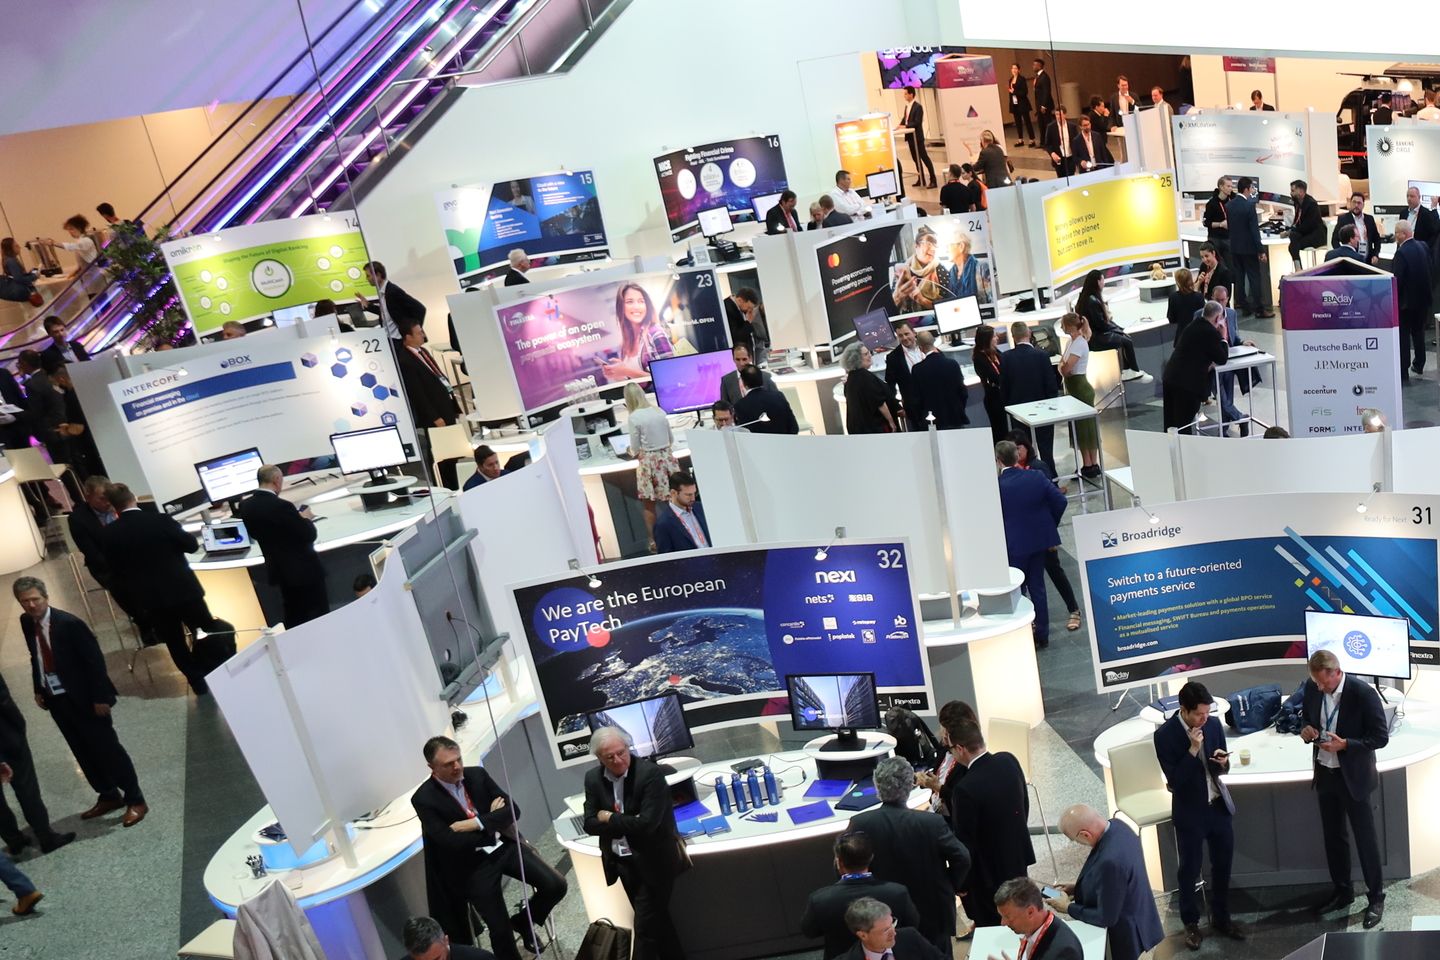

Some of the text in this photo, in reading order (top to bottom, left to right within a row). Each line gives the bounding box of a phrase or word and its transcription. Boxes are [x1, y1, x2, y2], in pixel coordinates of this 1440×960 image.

[1295, 128, 1302, 137] 46
[768, 138, 779, 148] 16
[701, 148, 720, 158] Financial
[580, 174, 592, 185] 15
[1160, 176, 1172, 188] 25
[345, 217, 359, 230] 14
[1085, 212, 1096, 222] you
[968, 220, 982, 232] 24
[1082, 223, 1100, 235] planet
[1076, 239, 1088, 248] save
[696, 274, 713, 288] 23
[831, 273, 851, 286] Powering
[858, 276, 872, 286] people
[1322, 294, 1353, 305] EBAday
[515, 319, 606, 352] The power of an open
[556, 332, 602, 350] ecosystem
[362, 339, 382, 354] 22
[1302, 342, 1362, 352] Deutsche Bank
[228, 354, 252, 368] BOX
[1314, 360, 1369, 372] J.P.Morgan
[122, 374, 180, 396] INTERCOPE
[1304, 386, 1337, 394] accenture
[1312, 408, 1332, 416] FIS
[1364, 515, 1382, 524] Ready
[1412, 506, 1432, 525] 31
[1122, 526, 1182, 542] Broadridge
[877, 549, 903, 568] 32
[815, 570, 856, 584] nexi
[1108, 558, 1242, 588] Switch to a future-oriented
[1110, 580, 1196, 605] payments service
[541, 578, 726, 622] We are the European
[806, 595, 828, 604] nets
[1116, 609, 1158, 621] Market-leading
[1158, 606, 1184, 616] payments
[1184, 602, 1206, 610] solution
[1224, 596, 1240, 605] global
[1118, 622, 1142, 632] Financial
[1143, 618, 1172, 629] messaging,
[1173, 613, 1190, 621] SWIFT
[1220, 606, 1246, 616] payments
[1246, 604, 1276, 612] operations
[549, 615, 622, 644] PayTech
[1130, 626, 1160, 636] mutualised
[1160, 623, 1179, 631] service
[1117, 640, 1159, 652] broadridge.com
